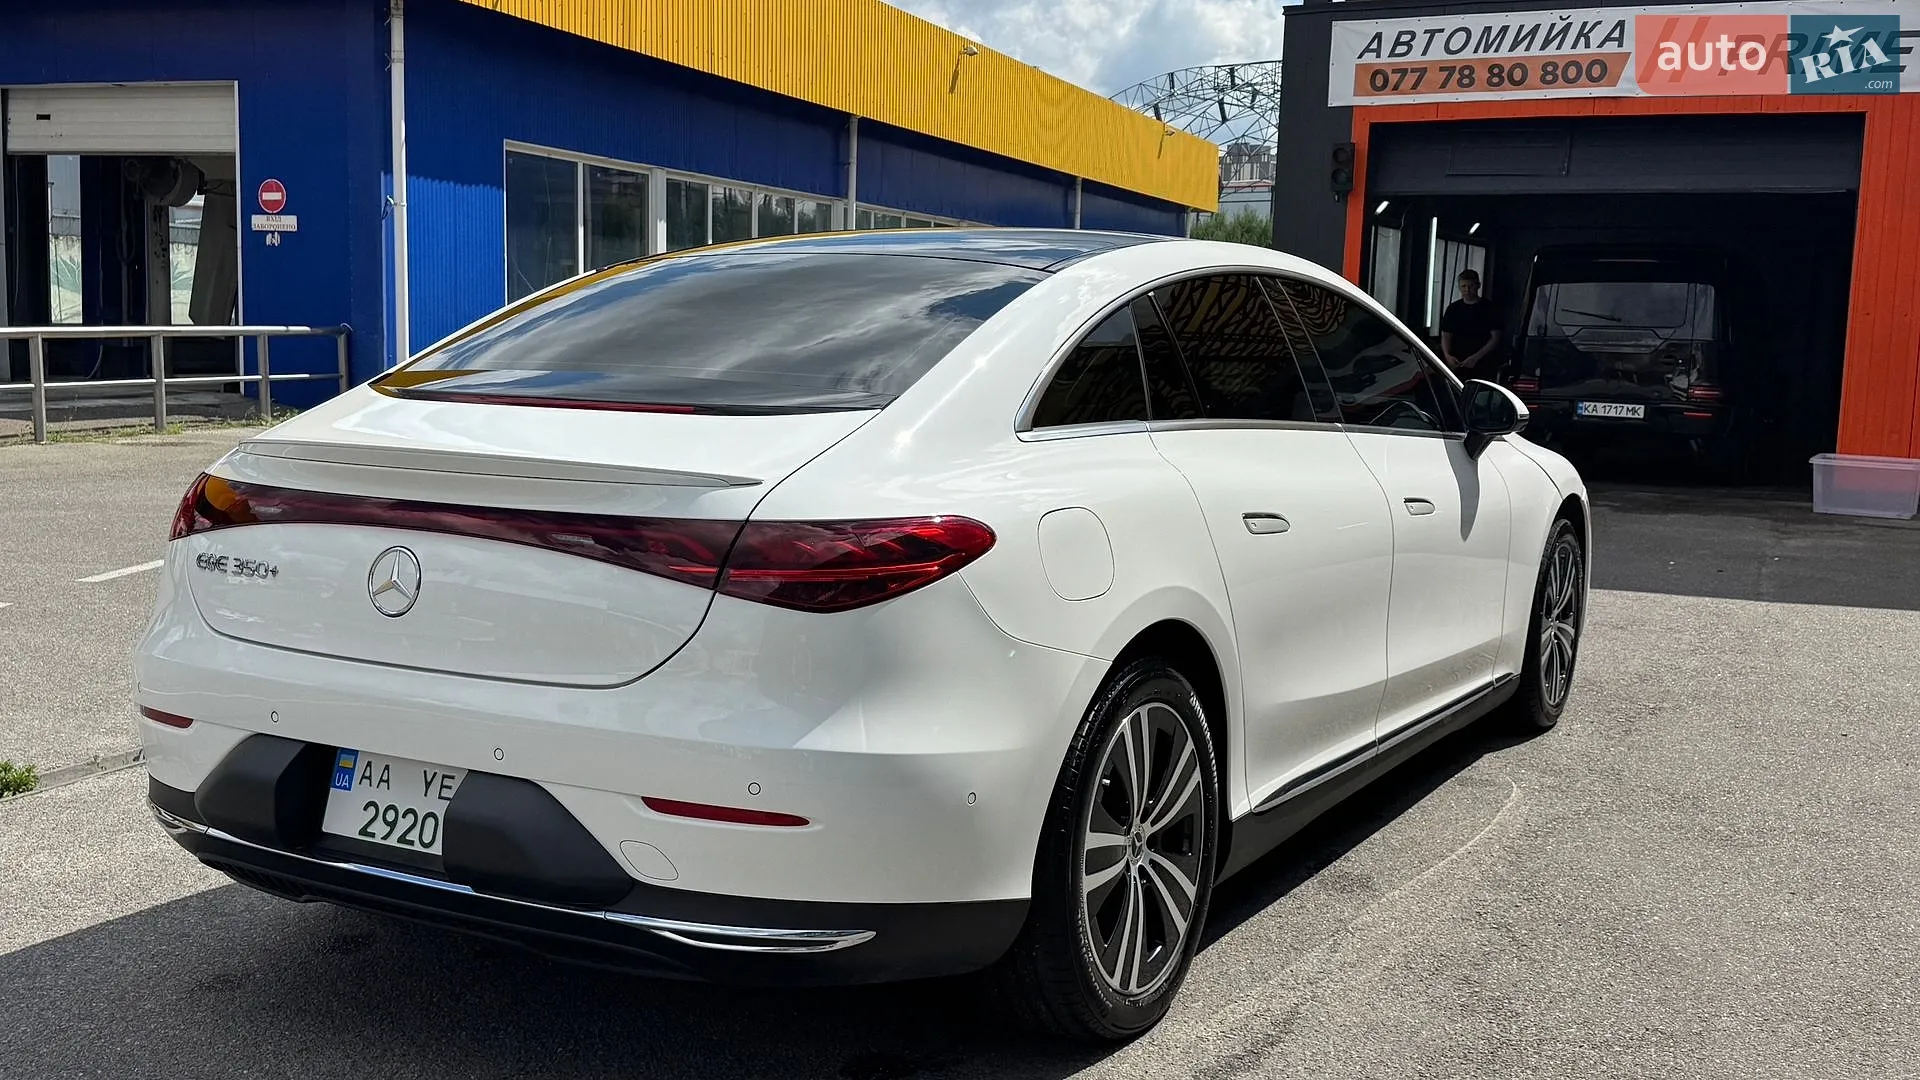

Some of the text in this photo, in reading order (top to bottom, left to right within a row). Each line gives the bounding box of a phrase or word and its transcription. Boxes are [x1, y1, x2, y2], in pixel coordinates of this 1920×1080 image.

[1357, 15, 1626, 59] АВТОМИЙКА
[1369, 58, 1608, 92] 077 78 80 800
[1583, 404, 1598, 414] KA
[1601, 405, 1624, 415] 1717
[1625, 406, 1642, 416] MK
[231, 558, 279, 579] 350+
[335, 773, 349, 788] UA
[358, 760, 456, 801] AA YE
[358, 800, 439, 849] 2920
